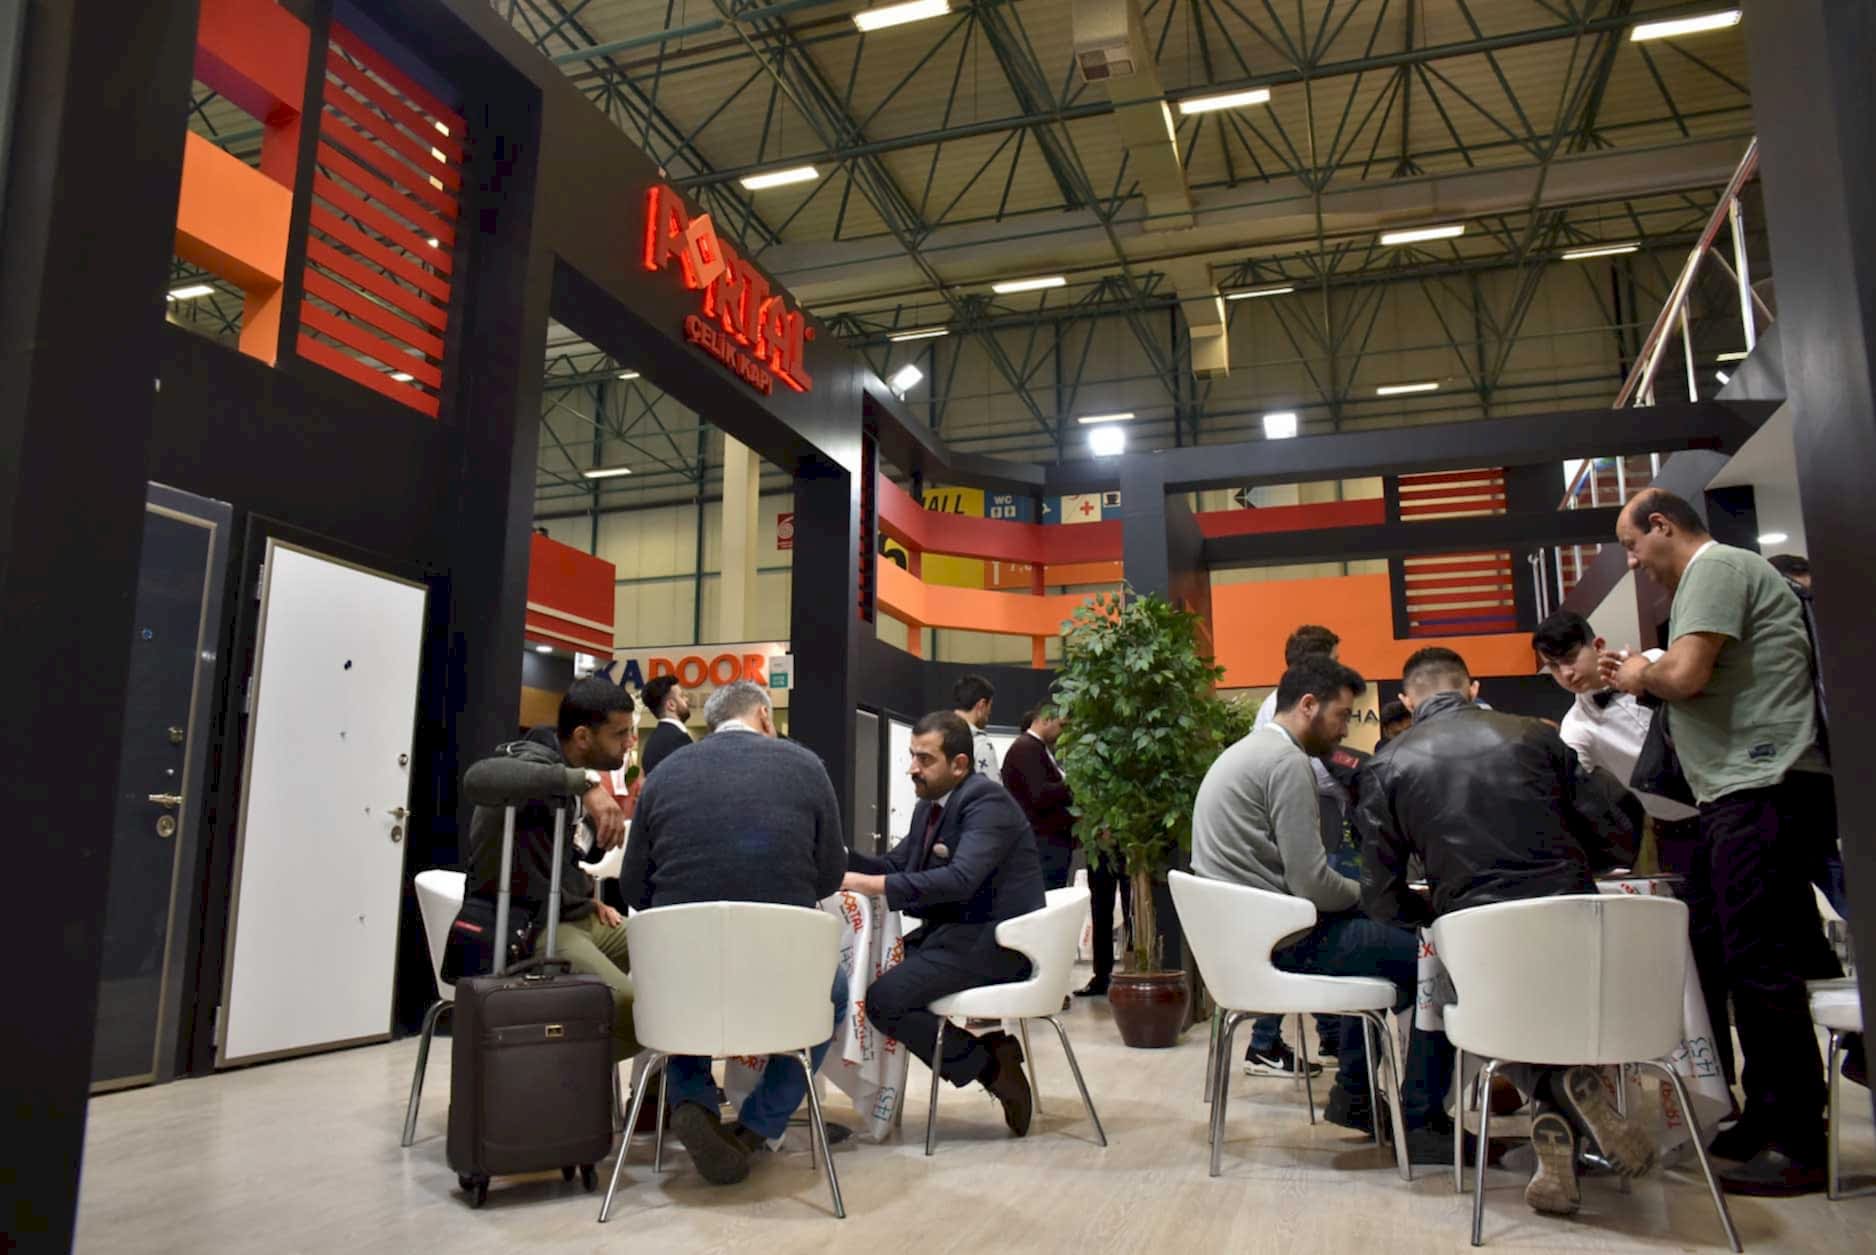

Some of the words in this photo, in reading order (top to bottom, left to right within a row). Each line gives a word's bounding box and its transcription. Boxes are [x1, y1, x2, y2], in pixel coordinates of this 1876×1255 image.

[643, 184, 813, 393] PORTAL
[924, 493, 966, 515] ALL
[993, 495, 1013, 505] WC
[1688, 1036, 1716, 1079] 1453
